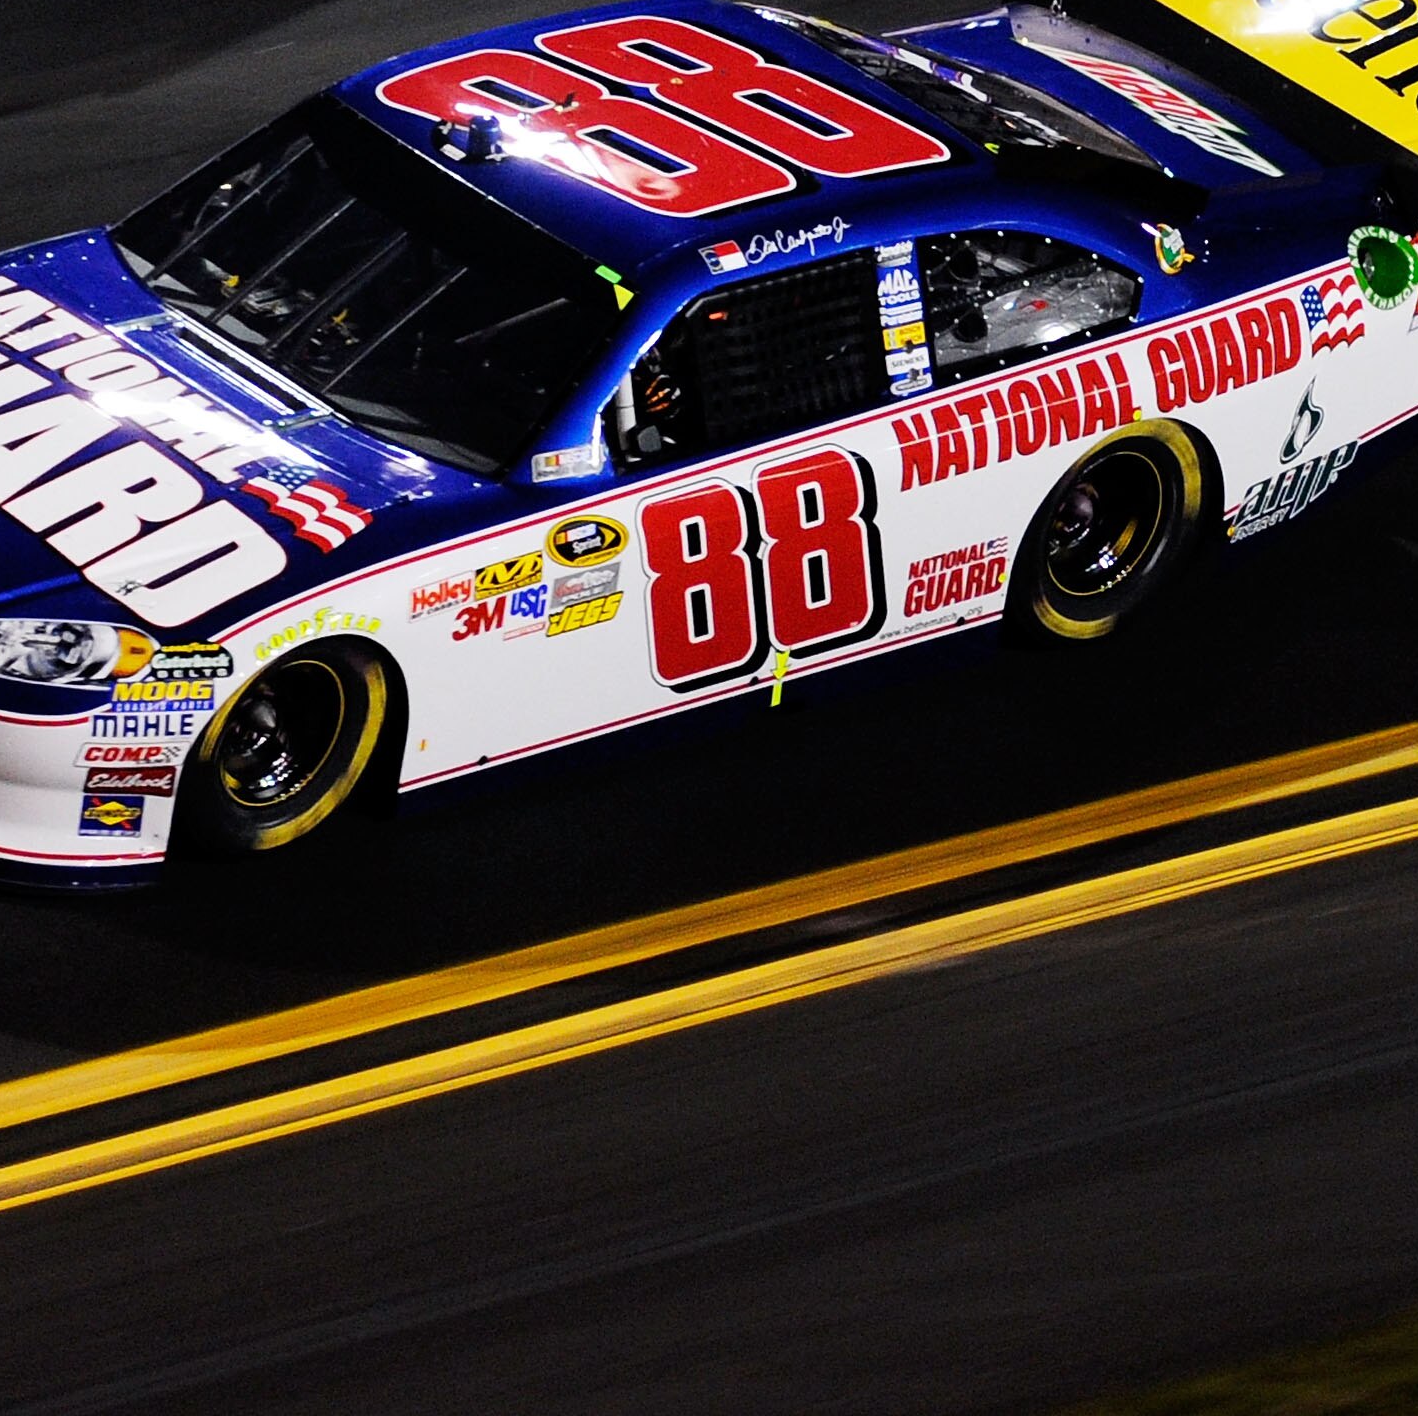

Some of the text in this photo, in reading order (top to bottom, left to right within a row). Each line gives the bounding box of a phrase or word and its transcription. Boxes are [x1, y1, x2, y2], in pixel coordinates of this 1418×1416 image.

[375, 15, 951, 218] 88
[877, 268, 920, 298] MAC
[878, 288, 921, 307] TOOLS
[892, 297, 1301, 491] NATIONAL GUARD
[637, 445, 881, 689] 88
[908, 542, 985, 580] NATIONAL
[412, 578, 472, 613] Holley
[510, 584, 548, 619] USG
[903, 556, 1006, 618] GUARD
[452, 596, 507, 642] 3M
[545, 590, 624, 638] JEGS
[254, 607, 383, 661] GOODYEAR
[112, 680, 214, 703] MOOG
[92, 714, 194, 738] MAHLE
[84, 746, 163, 762] COMP
[87, 769, 172, 790] Edelbrock
